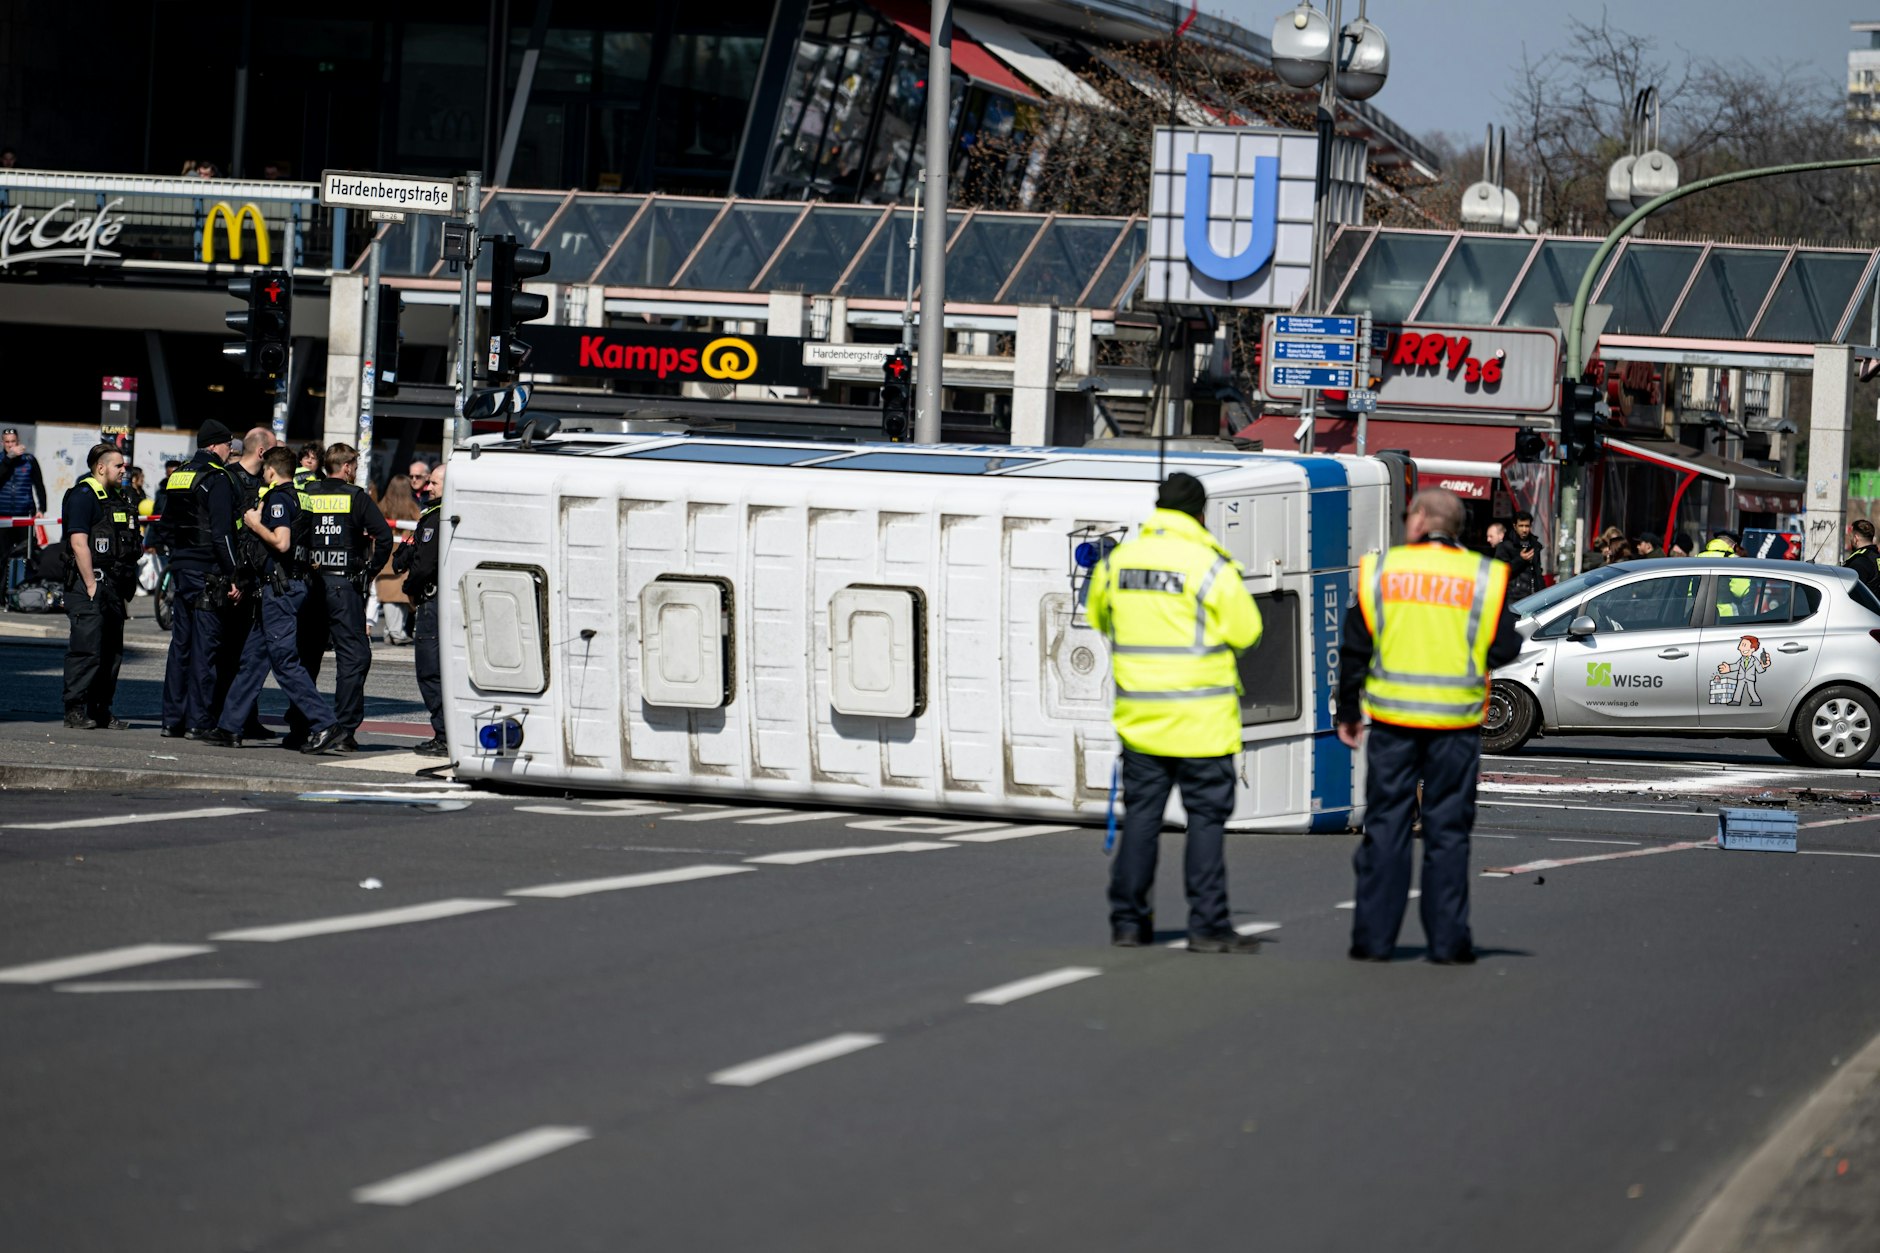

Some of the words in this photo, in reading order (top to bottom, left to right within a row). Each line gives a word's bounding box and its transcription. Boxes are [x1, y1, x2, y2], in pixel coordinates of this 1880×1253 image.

[331, 178, 448, 205] Hardenbergstraße
[1184, 153, 1279, 281] U
[0, 198, 125, 267] McCafé
[579, 335, 699, 379] Kamps
[1391, 333, 1472, 370] RRY
[1464, 358, 1500, 383] 36
[1440, 479, 1475, 492] CURRY
[312, 498, 348, 510] POLIZEI
[314, 525, 342, 535] 14100
[321, 515, 334, 525] BE
[309, 550, 348, 566] POLIZEI
[1387, 572, 1471, 607] POLIZEI
[1324, 583, 1340, 687] POLIZEI
[1586, 699, 1639, 708] www.wisag.de
